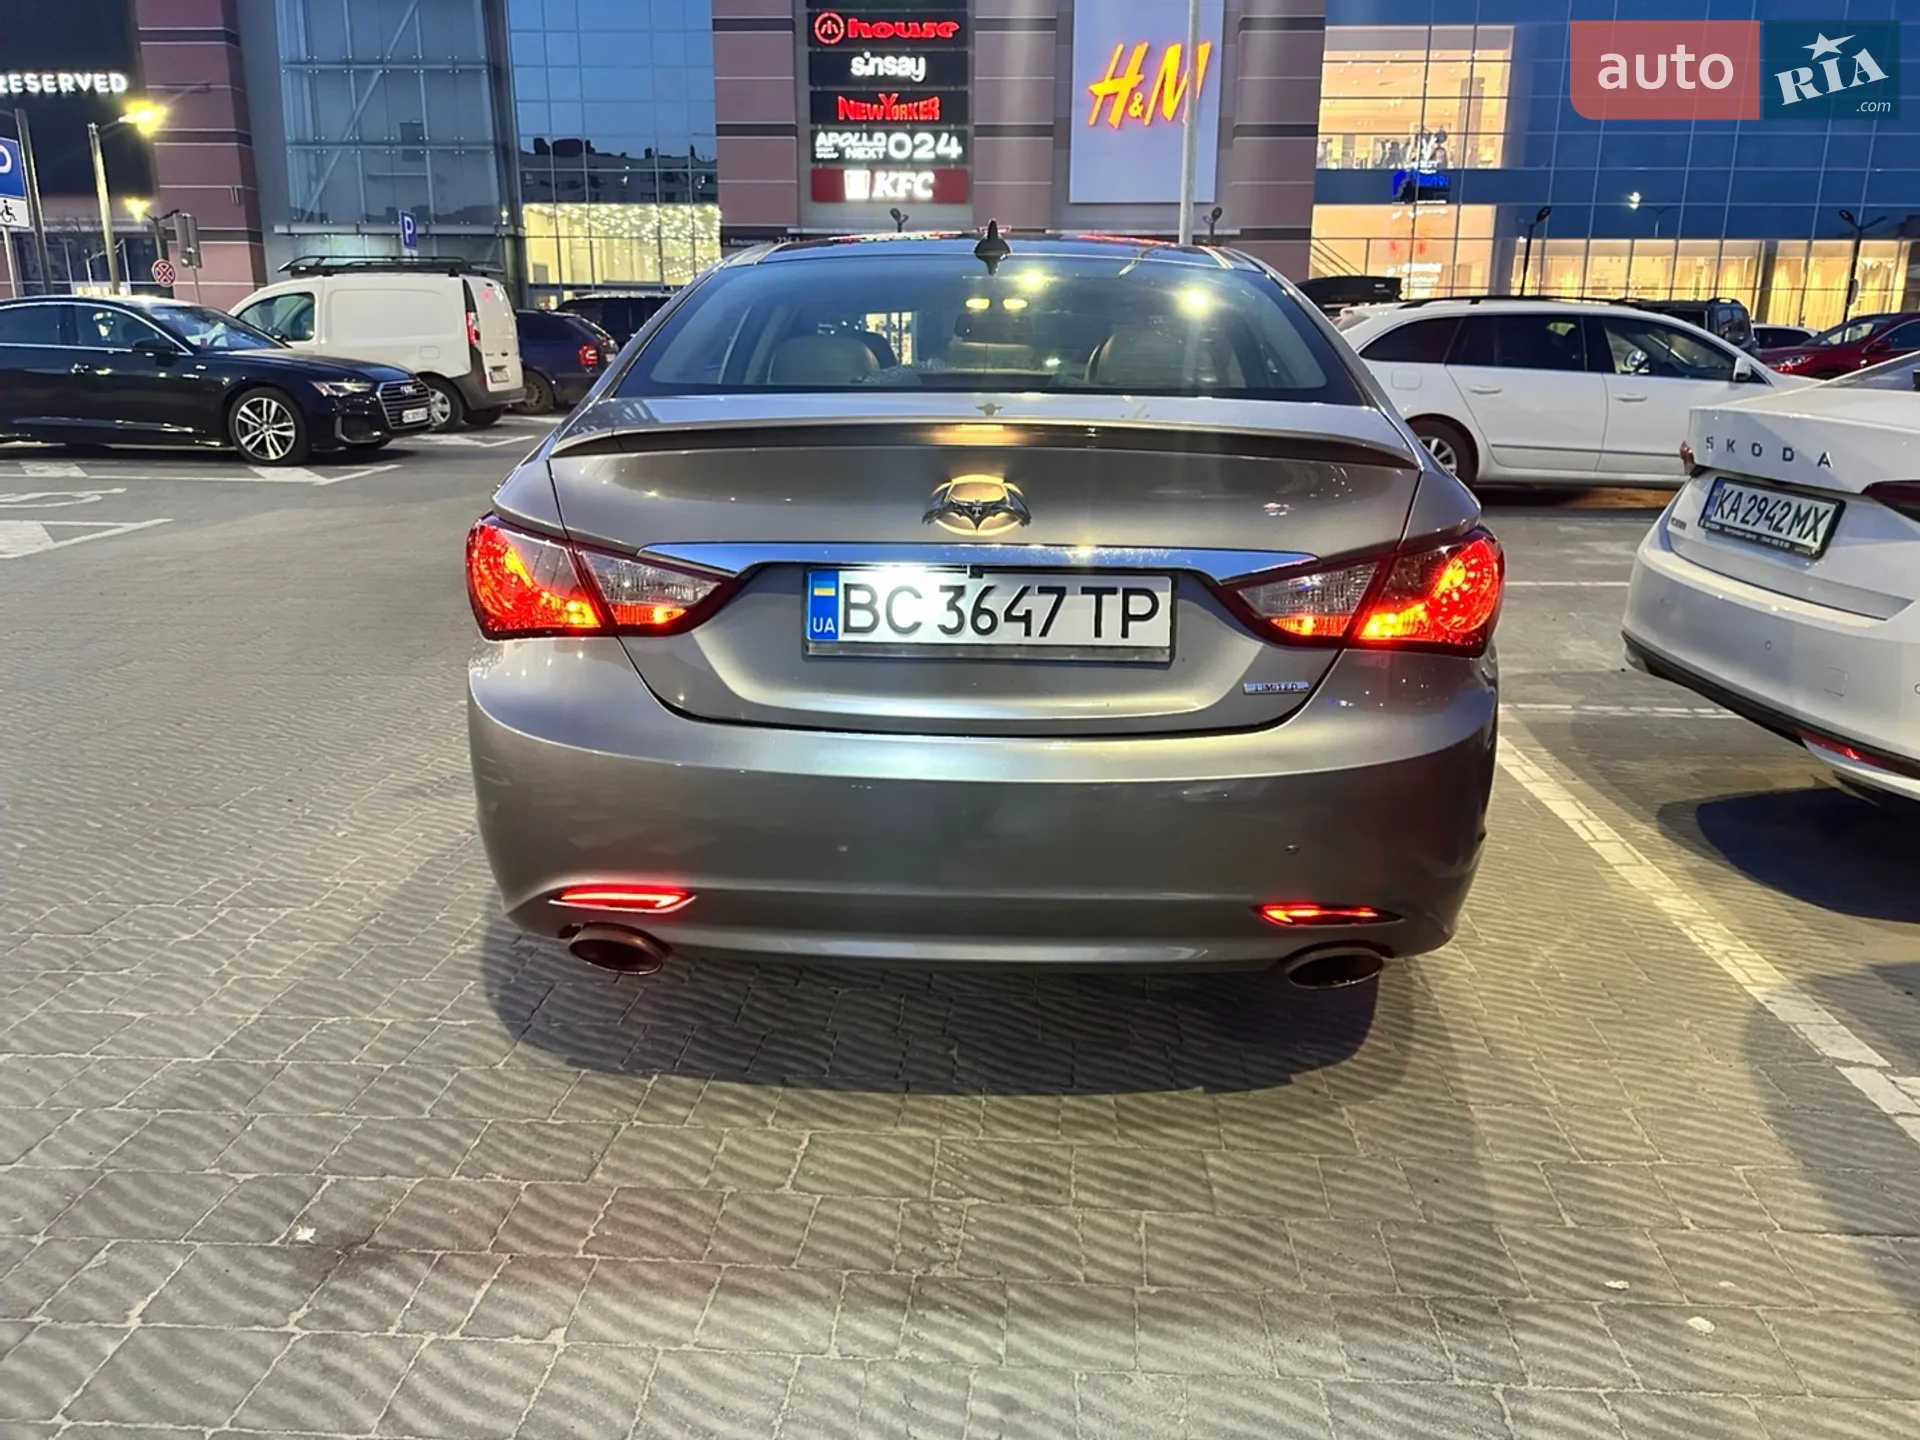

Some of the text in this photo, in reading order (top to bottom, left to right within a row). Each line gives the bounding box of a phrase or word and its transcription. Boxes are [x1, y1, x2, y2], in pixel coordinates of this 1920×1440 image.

[848, 18, 959, 38] house
[850, 52, 926, 82] sinsay
[1088, 41, 1212, 130] H&M
[815, 131, 887, 147] APOLLO
[872, 170, 935, 200] KFC
[404, 216, 414, 244] P
[1706, 436, 1833, 468] SKODA
[813, 616, 836, 633] UA
[843, 583, 1160, 639] BC 3647 TP
